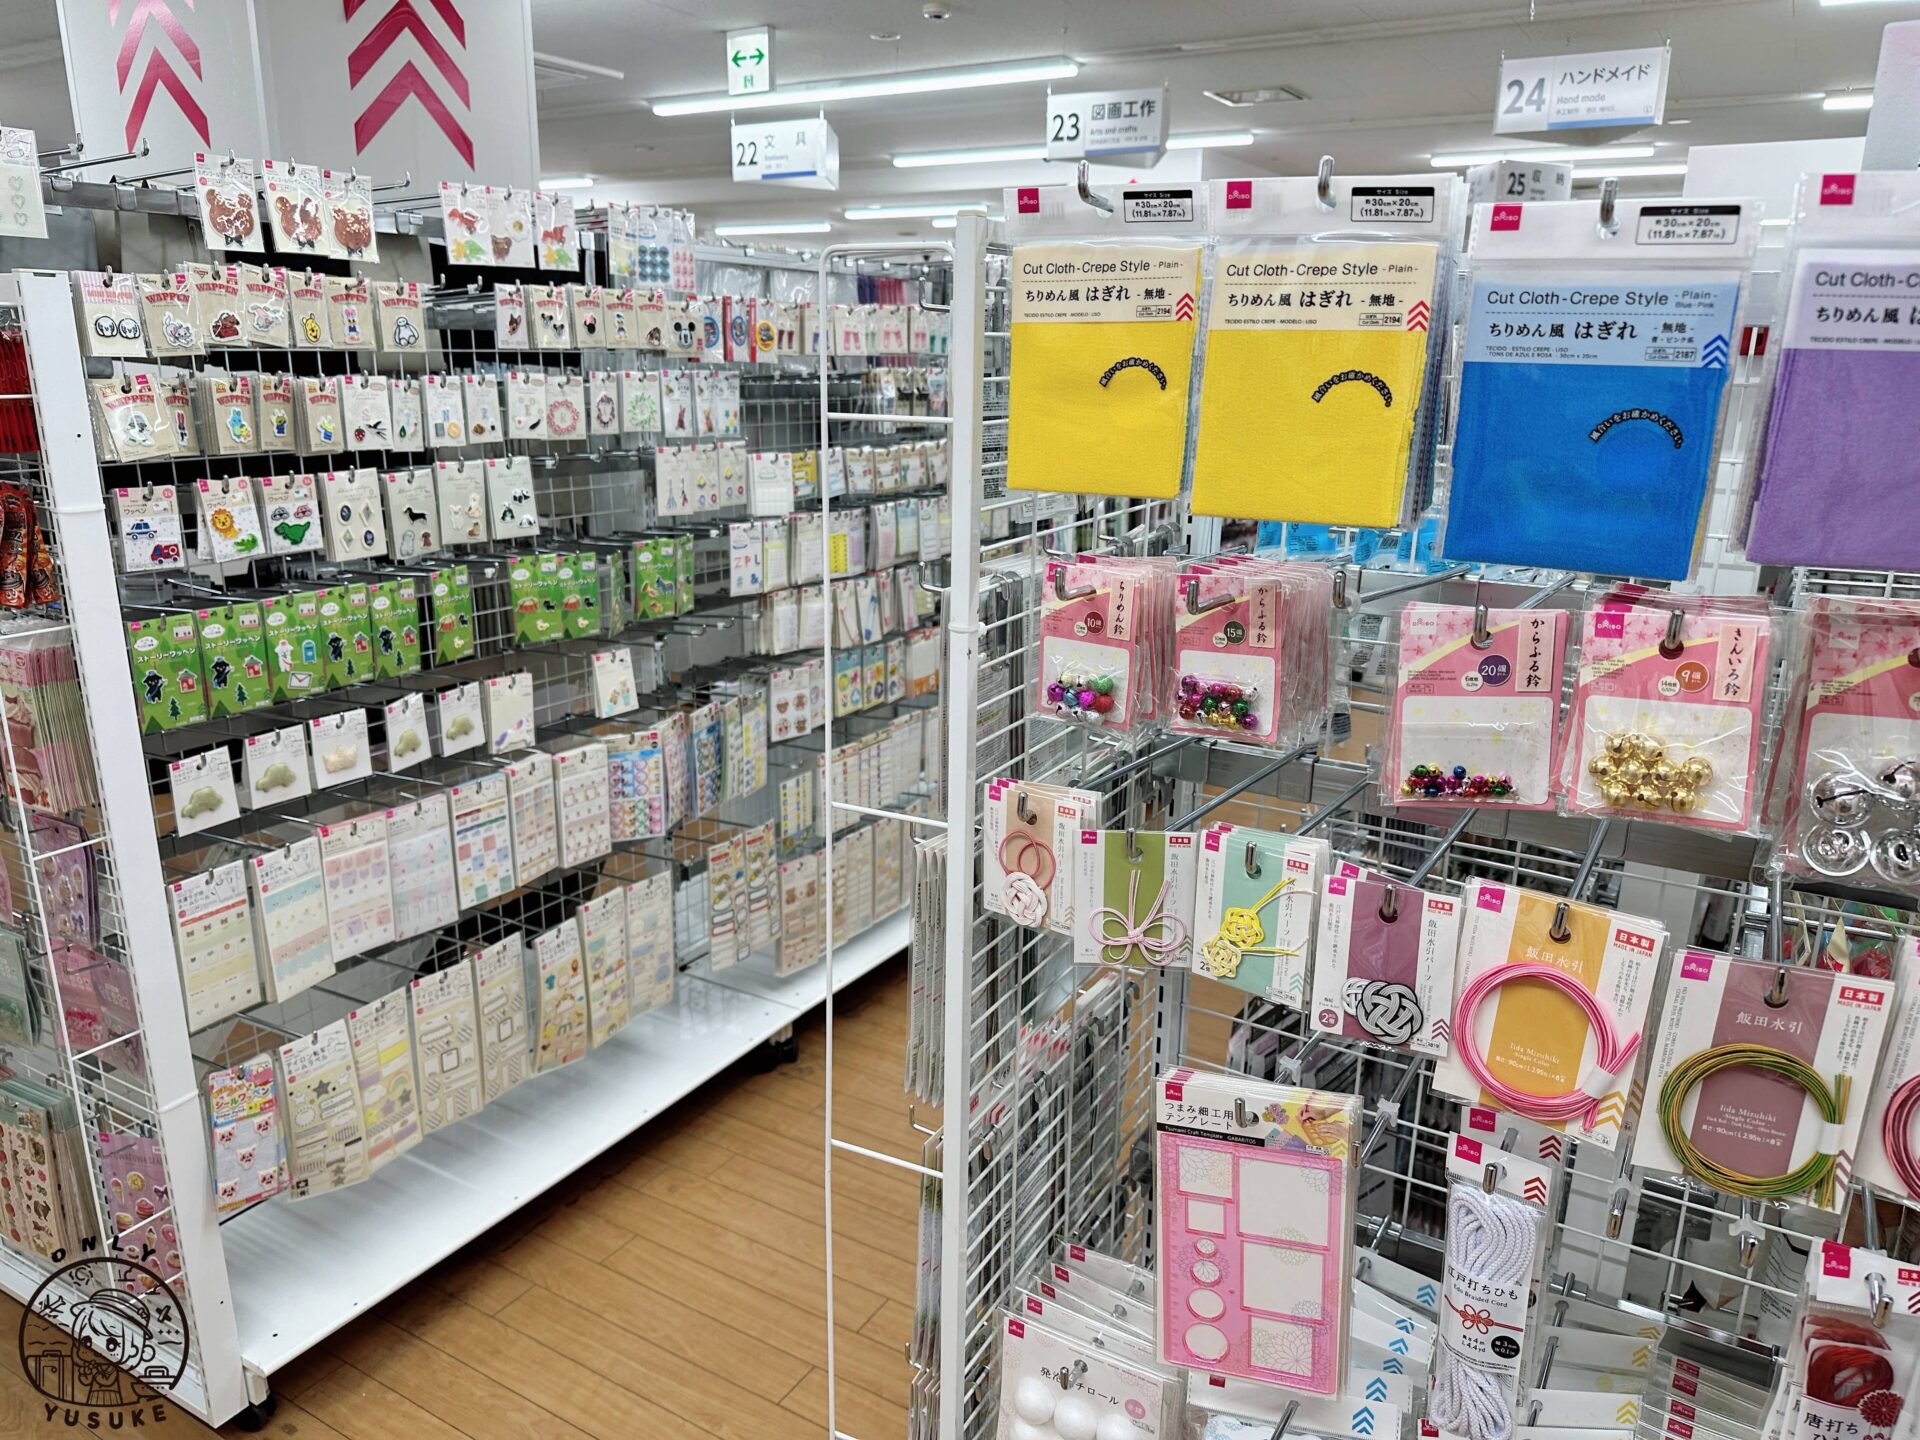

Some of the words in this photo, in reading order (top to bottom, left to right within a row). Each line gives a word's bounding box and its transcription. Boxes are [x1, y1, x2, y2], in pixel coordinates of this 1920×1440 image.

[1558, 63, 1652, 87] ハンドメイド
[1502, 77, 1546, 115] 24
[1556, 93, 1580, 105] Hand
[1581, 92, 1605, 104] made
[1092, 99, 1156, 121] 図画工作
[1051, 112, 1080, 142] 23
[736, 141, 758, 167] 22
[1507, 171, 1526, 197] 25
[1019, 196, 1038, 205] DAISO
[1228, 190, 1250, 200] DAISO
[1493, 210, 1519, 222] DAISO
[1023, 262, 1043, 275] Cut
[1120, 260, 1150, 275] Style
[1226, 264, 1250, 277] Cut
[1342, 262, 1378, 277] Style
[1815, 271, 1846, 287] Cut
[195, 283, 239, 296] WAPPEN
[1025, 289, 1080, 302] ちりめん風
[1086, 285, 1131, 302] はぎれ
[145, 292, 190, 304] WAPPEN
[382, 298, 419, 308] WAPPEN
[1227, 293, 1291, 307] ちりめん風
[1299, 290, 1353, 307] はぎれ
[1487, 291, 1514, 305] Cut
[1625, 291, 1668, 306] Style
[1157, 307, 1171, 315] 2194
[1816, 306, 1901, 325] ちりめん風
[1489, 323, 1565, 339] ちりめん風
[1575, 321, 1638, 341] はぎれ
[1674, 350, 1695, 360] 2187
[322, 612, 368, 626] ストーリーワッペン
[374, 607, 417, 620] ストーリーワッペン
[1255, 586, 1268, 643] からふる鈴
[268, 624, 318, 637] ストーリーワッペン
[1597, 619, 1622, 631] DAISO
[204, 635, 262, 651] ストーリーワッペン
[136, 648, 196, 664] ストーリーワッペン
[1525, 618, 1545, 688] からふる鈴
[1724, 627, 1744, 696] きんいろ鈴
[1430, 901, 1451, 911] 日本製
[1480, 893, 1502, 906] DAISO
[1619, 932, 1650, 949] 日本製
[1425, 919, 1437, 981] 飯田水引パーツ
[1613, 942, 1627, 952] MADE
[1636, 948, 1653, 958] JAPAN
[1525, 946, 1584, 975] 飯田水引
[1684, 963, 1709, 976] DAISO
[1844, 988, 1880, 1003] 日本製
[1837, 1000, 1853, 1008] MADE
[1863, 1003, 1882, 1012] JAPAN
[1736, 1012, 1803, 1034] 飯田水引
[1165, 1103, 1234, 1121] つまみ細工用
[1471, 1114, 1495, 1126] DAISO
[1720, 1104, 1736, 1114] Iida
[1738, 1108, 1777, 1123] Mizuhiki
[1165, 1112, 1233, 1131] テンプレート
[1187, 1128, 1200, 1136] Craft
[1200, 1130, 1223, 1140] Template
[1227, 1135, 1257, 1145] GABARITOS
[1458, 1143, 1480, 1158] DAISO
[1825, 1260, 1848, 1271] DAISO
[1448, 1265, 1518, 1300] 江戸打ちひも
[1464, 1291, 1489, 1304] Braided
[1491, 1299, 1508, 1308] Cord
[1040, 1366, 1119, 1406] 発泡チロール
[1803, 1412, 1859, 1435] 唐打ち
